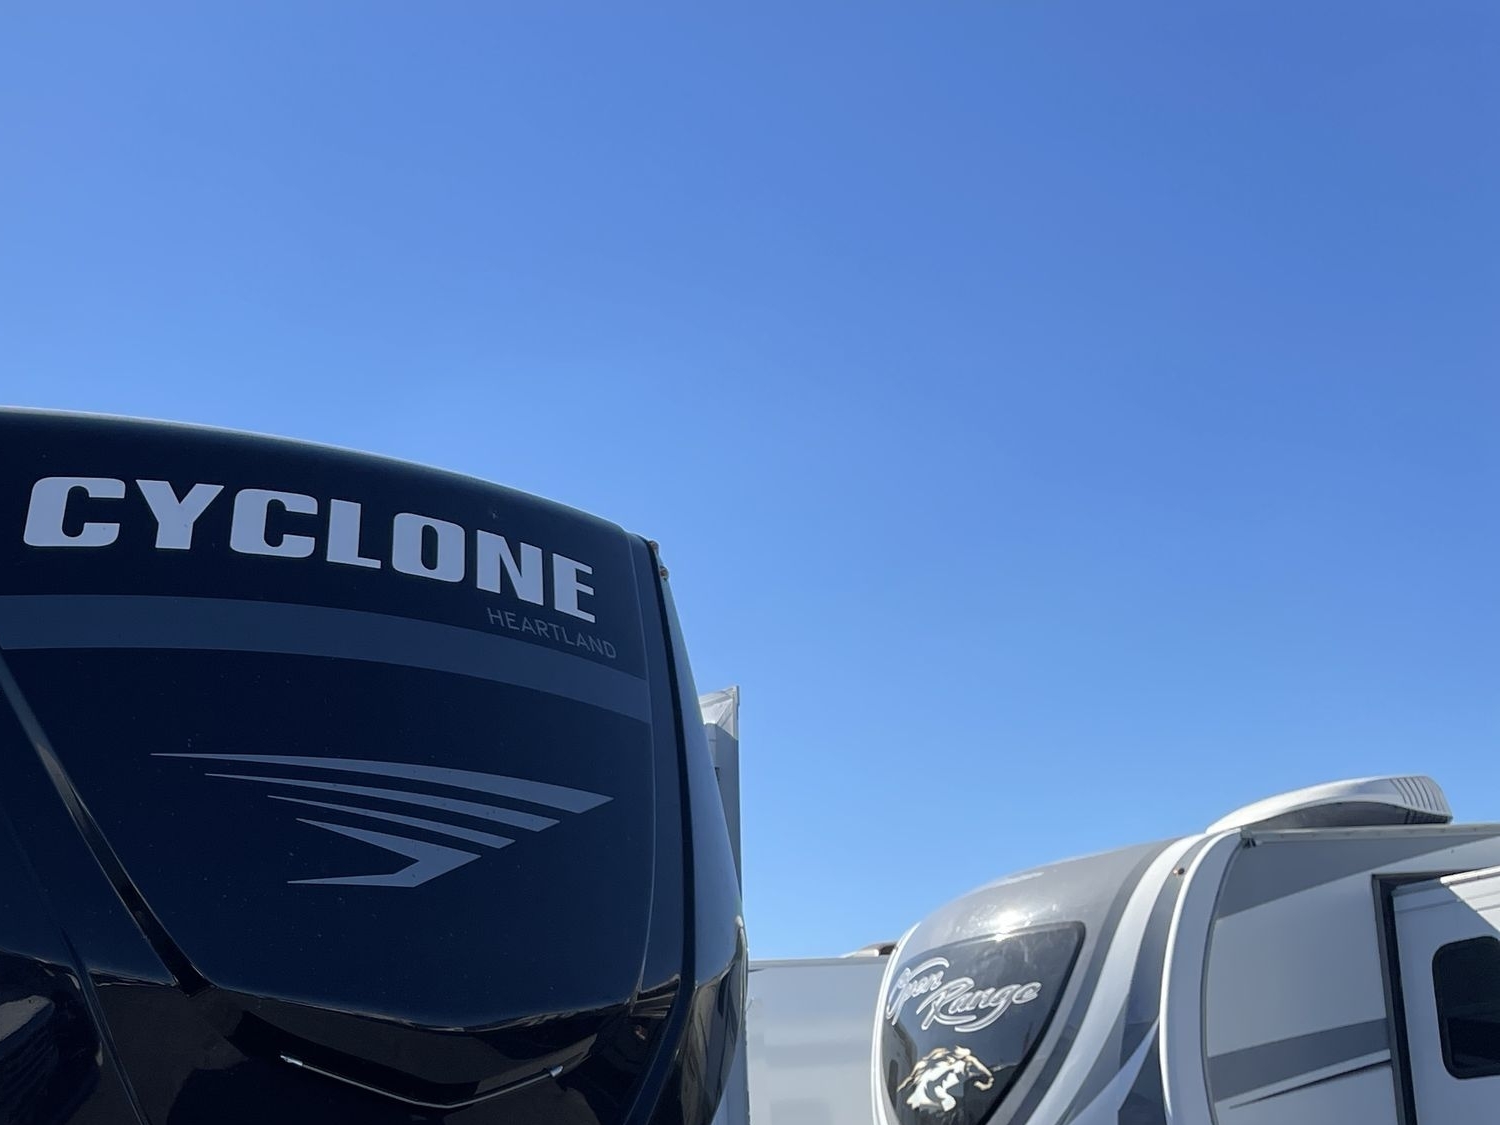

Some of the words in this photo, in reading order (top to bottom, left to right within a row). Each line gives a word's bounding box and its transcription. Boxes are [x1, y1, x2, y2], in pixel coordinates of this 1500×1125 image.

[23, 476, 596, 624] CYCLONE
[487, 607, 617, 659] HEARTLAND
[886, 957, 950, 1026] Open
[916, 977, 1042, 1033] Range
